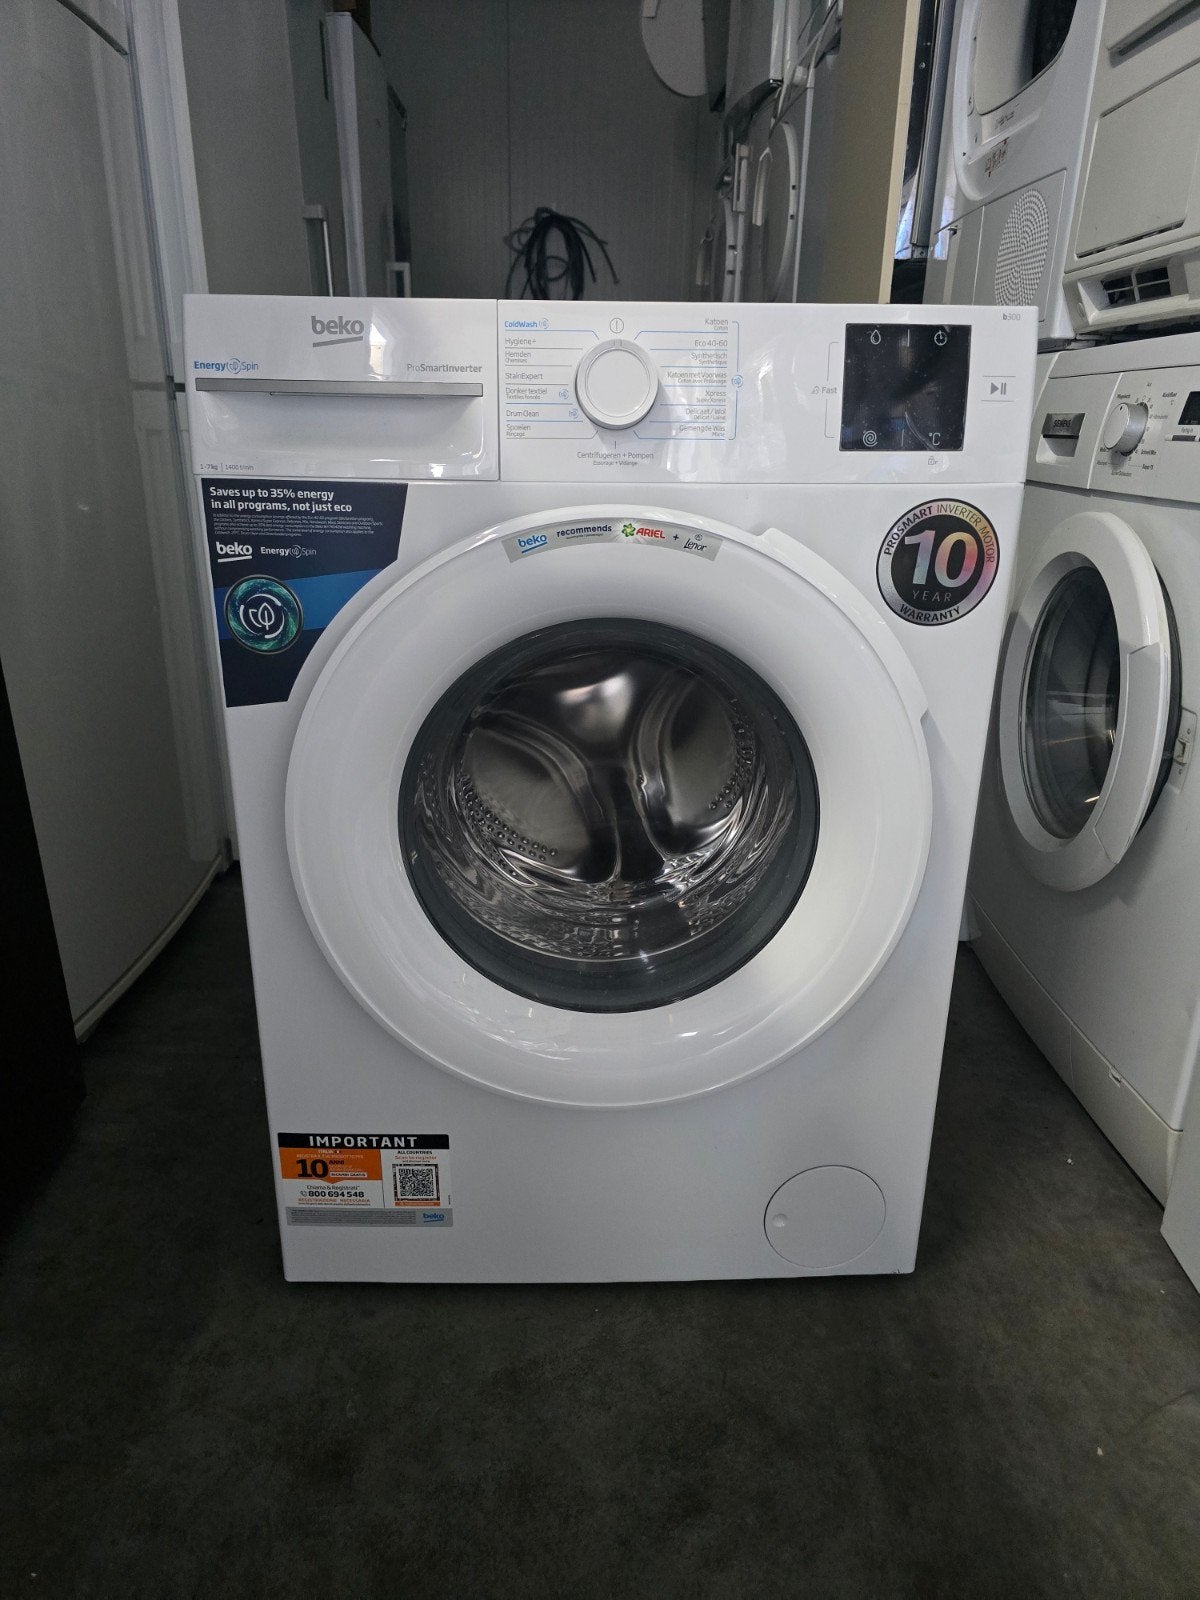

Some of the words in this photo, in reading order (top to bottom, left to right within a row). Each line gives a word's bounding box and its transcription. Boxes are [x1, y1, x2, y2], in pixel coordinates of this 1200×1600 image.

[704, 318, 729, 326] Katoen
[1003, 313, 1021, 321] b300
[311, 315, 365, 335] beko
[504, 320, 538, 328] ColdWash
[504, 337, 537, 347] Hygiene+
[694, 339, 706, 347] Eco
[707, 339, 728, 347] 40-60
[504, 350, 532, 358] Hemden
[194, 360, 226, 372] Energy
[241, 360, 259, 372] Spin
[406, 362, 483, 374] ProSmartInverter
[505, 372, 543, 381] StainExpert
[667, 371, 688, 379] Katoen
[505, 387, 527, 395] Donker
[528, 387, 548, 395] textiel
[705, 389, 727, 398] Xpress
[821, 386, 837, 395] Fast
[506, 423, 532, 432] Spoelen
[576, 451, 622, 460] Centrifugeren
[627, 451, 655, 460] Pompen
[209, 486, 241, 498] Saves
[242, 488, 256, 499] up
[257, 488, 269, 498] to
[270, 488, 296, 499] 35%
[297, 489, 335, 501] energy
[211, 499, 222, 509] in
[223, 499, 236, 510] all
[237, 501, 291, 512] programs,
[292, 502, 311, 512] not
[311, 502, 333, 513] just
[334, 503, 353, 512] eco
[518, 534, 549, 549] beko
[556, 524, 613, 538] recommends
[883, 505, 934, 556] PROSMART
[936, 503, 983, 527] INVERTER
[978, 526, 996, 564] MOTOR
[635, 527, 666, 539] ARIEL
[683, 538, 708, 551] Lenor
[215, 541, 253, 556] beko
[260, 546, 290, 557] Energy
[301, 546, 317, 557] Spin
[904, 529, 979, 588] 10
[912, 589, 952, 602] YEAR
[899, 603, 961, 623] WARRANTY
[309, 1134, 418, 1149] IMPORTANT
[296, 1158, 329, 1178] 10
[308, 1190, 327, 1198] 800
[327, 1190, 346, 1198] 694
[422, 1212, 445, 1220] beko
